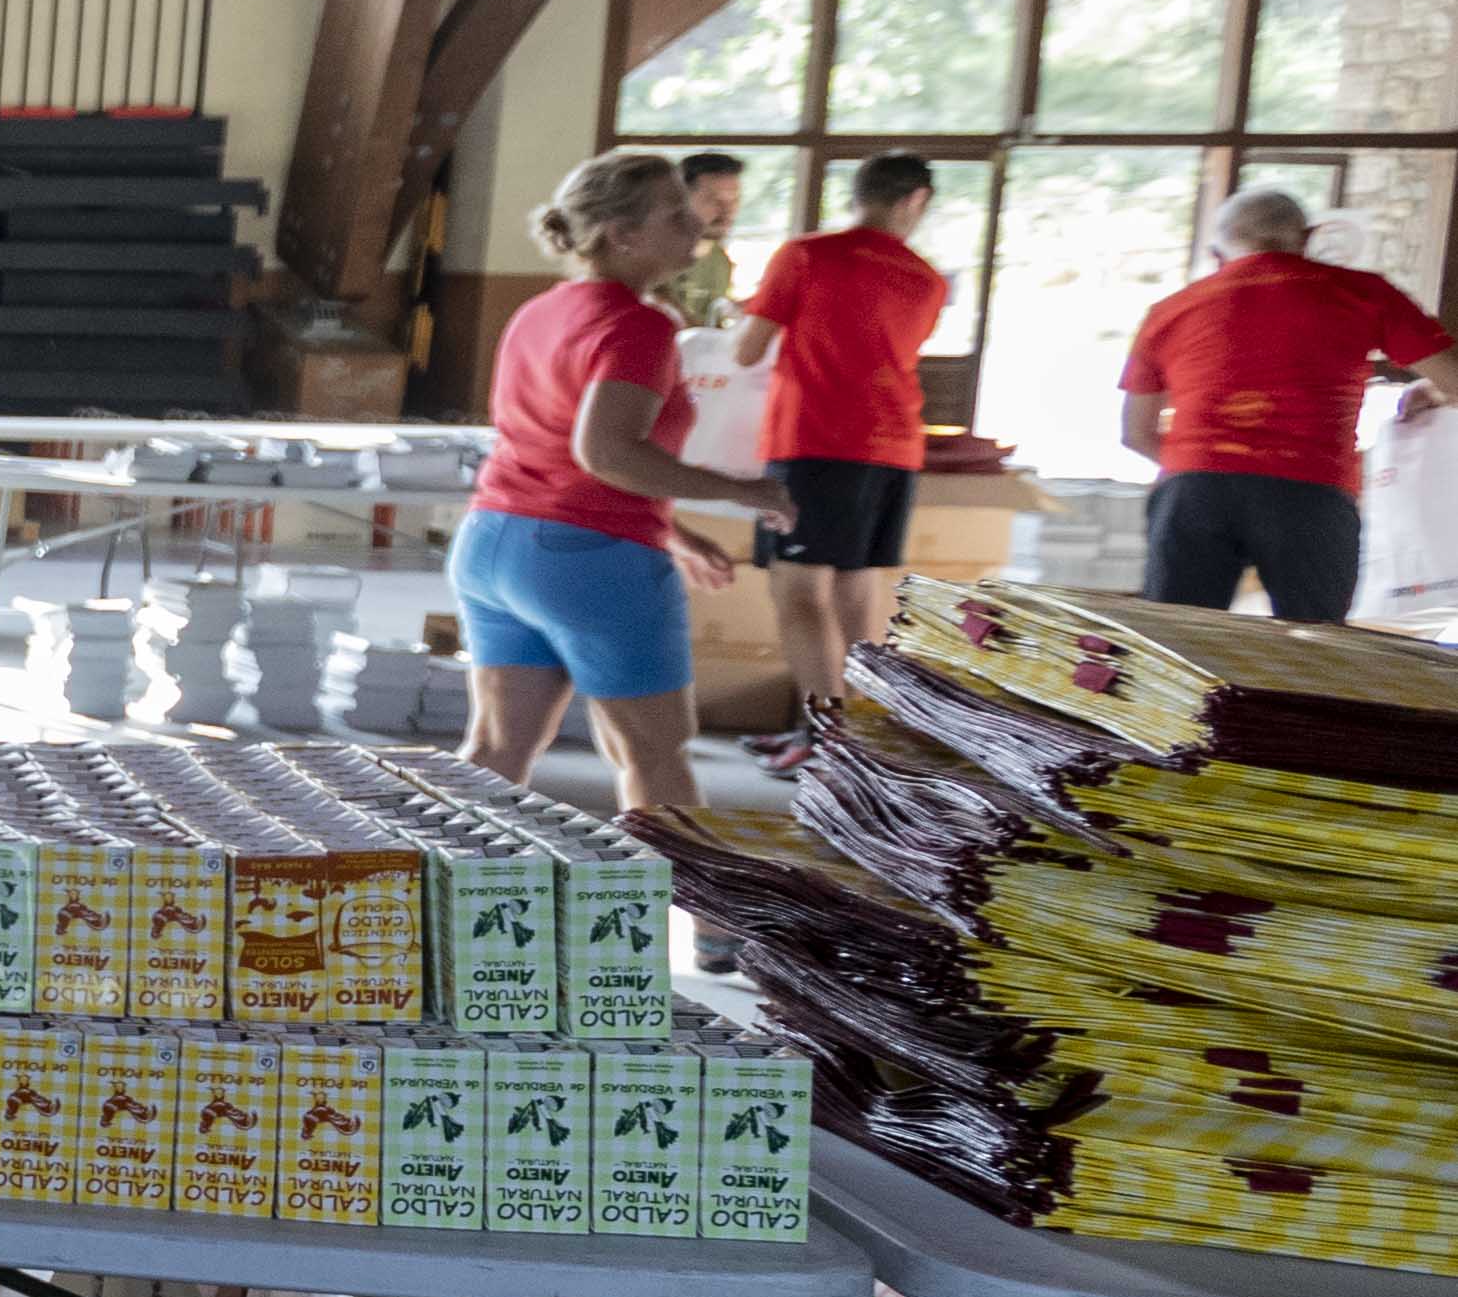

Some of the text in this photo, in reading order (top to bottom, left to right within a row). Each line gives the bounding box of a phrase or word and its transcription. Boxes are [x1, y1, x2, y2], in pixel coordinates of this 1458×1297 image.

[473, 968, 535, 985] ANETO
[589, 974, 655, 991] ANETO
[242, 990, 321, 1013] ANETO
[336, 988, 414, 1010] ANETO
[465, 988, 548, 1005] NATURAL
[579, 993, 665, 1010] NATURAL
[464, 1004, 549, 1021] CALDO
[579, 1009, 666, 1028] CALDO
[1, 1137, 59, 1157] ANETO
[96, 1144, 156, 1164] ANETO
[195, 1151, 257, 1170] ANETO
[298, 1158, 361, 1177] ANETO
[401, 1163, 462, 1182] ANETO
[507, 1167, 571, 1186] ANETO
[613, 1169, 678, 1188] ANETO
[86, 1177, 165, 1199] CALDO
[289, 1177, 373, 1195] NATURAL
[391, 1182, 476, 1200] NATURAL
[721, 1173, 789, 1194] ANETO
[184, 1185, 266, 1206] CALDO
[287, 1193, 372, 1214] CALDO
[497, 1186, 583, 1203] NATURAL
[602, 1188, 690, 1205] NATURAL
[710, 1194, 801, 1211] NATURAL
[390, 1198, 475, 1218] CALDO
[497, 1201, 582, 1220] CALDO
[602, 1204, 689, 1224] CALDO
[710, 1209, 801, 1230] CALDO
